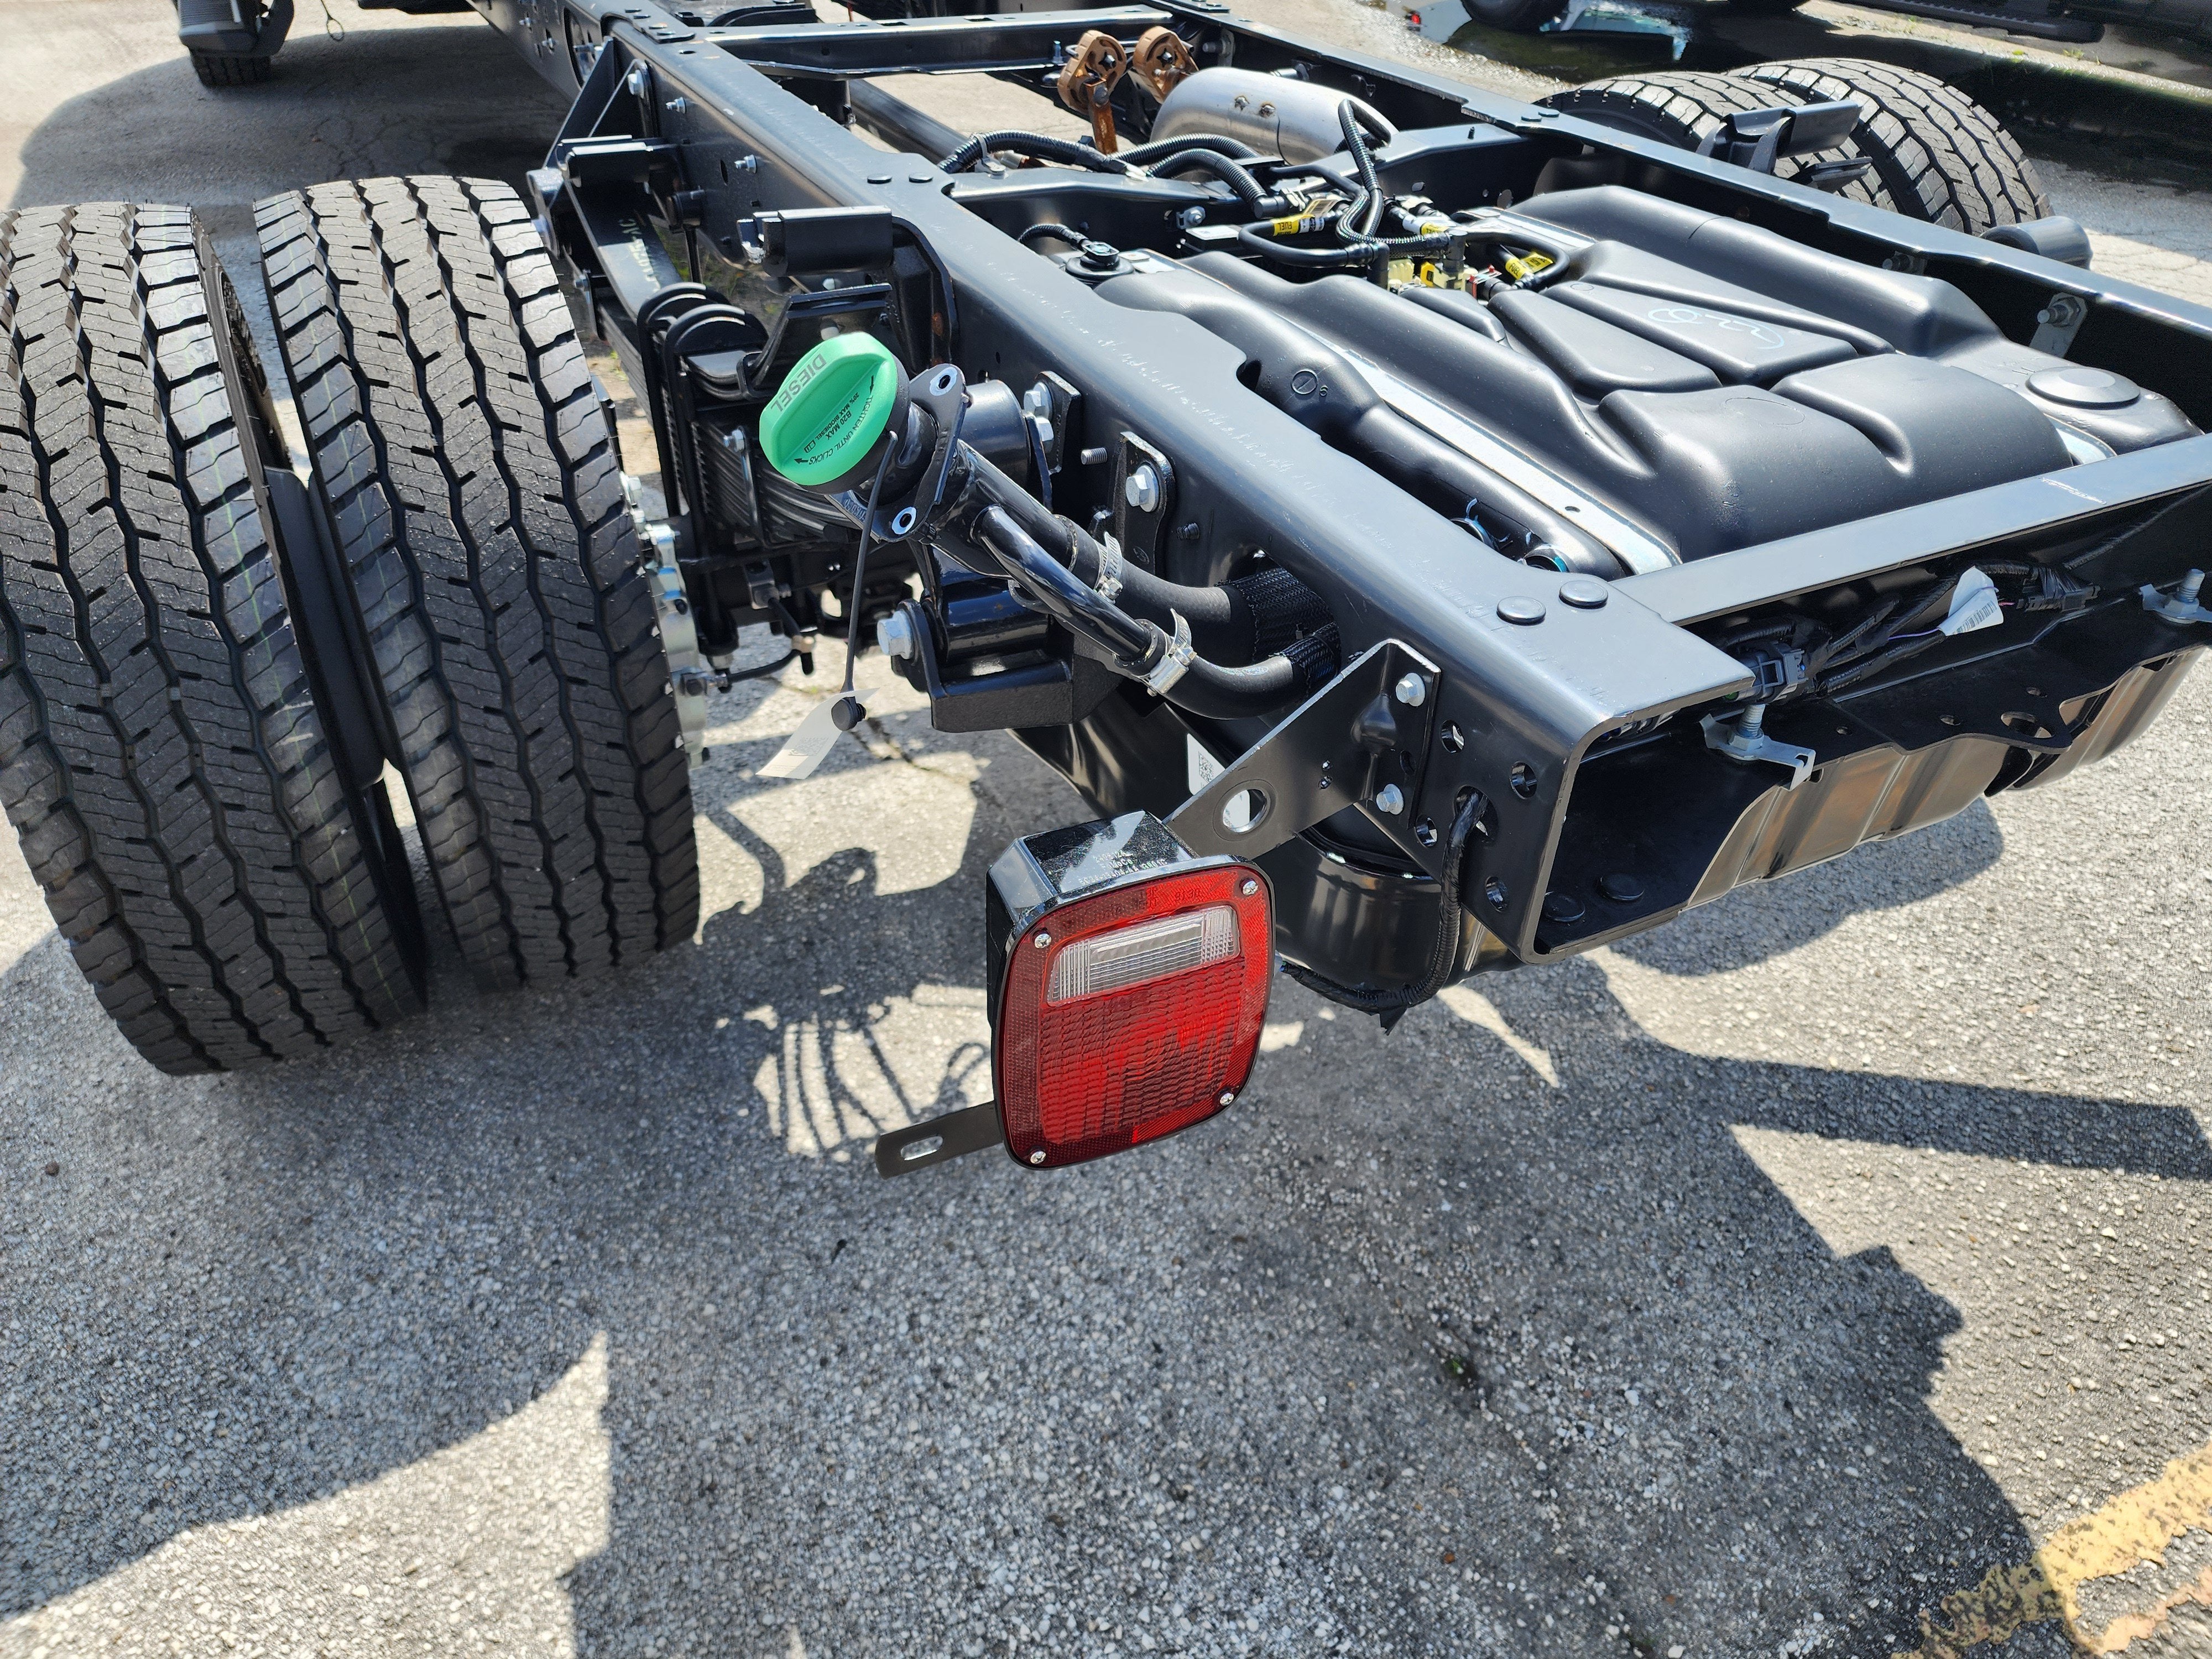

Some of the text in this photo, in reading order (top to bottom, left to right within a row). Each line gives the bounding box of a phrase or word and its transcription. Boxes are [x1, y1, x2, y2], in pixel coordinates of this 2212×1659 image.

[1278, 222, 1292, 231] FUEL
[1509, 263, 1521, 276] FUEL
[770, 353, 827, 412] DIESEL
[808, 395, 874, 465] TIGHTEN UNTIL CLICKS
[815, 392, 859, 440] 20% MAX BIODIESEL
[825, 410, 852, 440] B20 MAX
